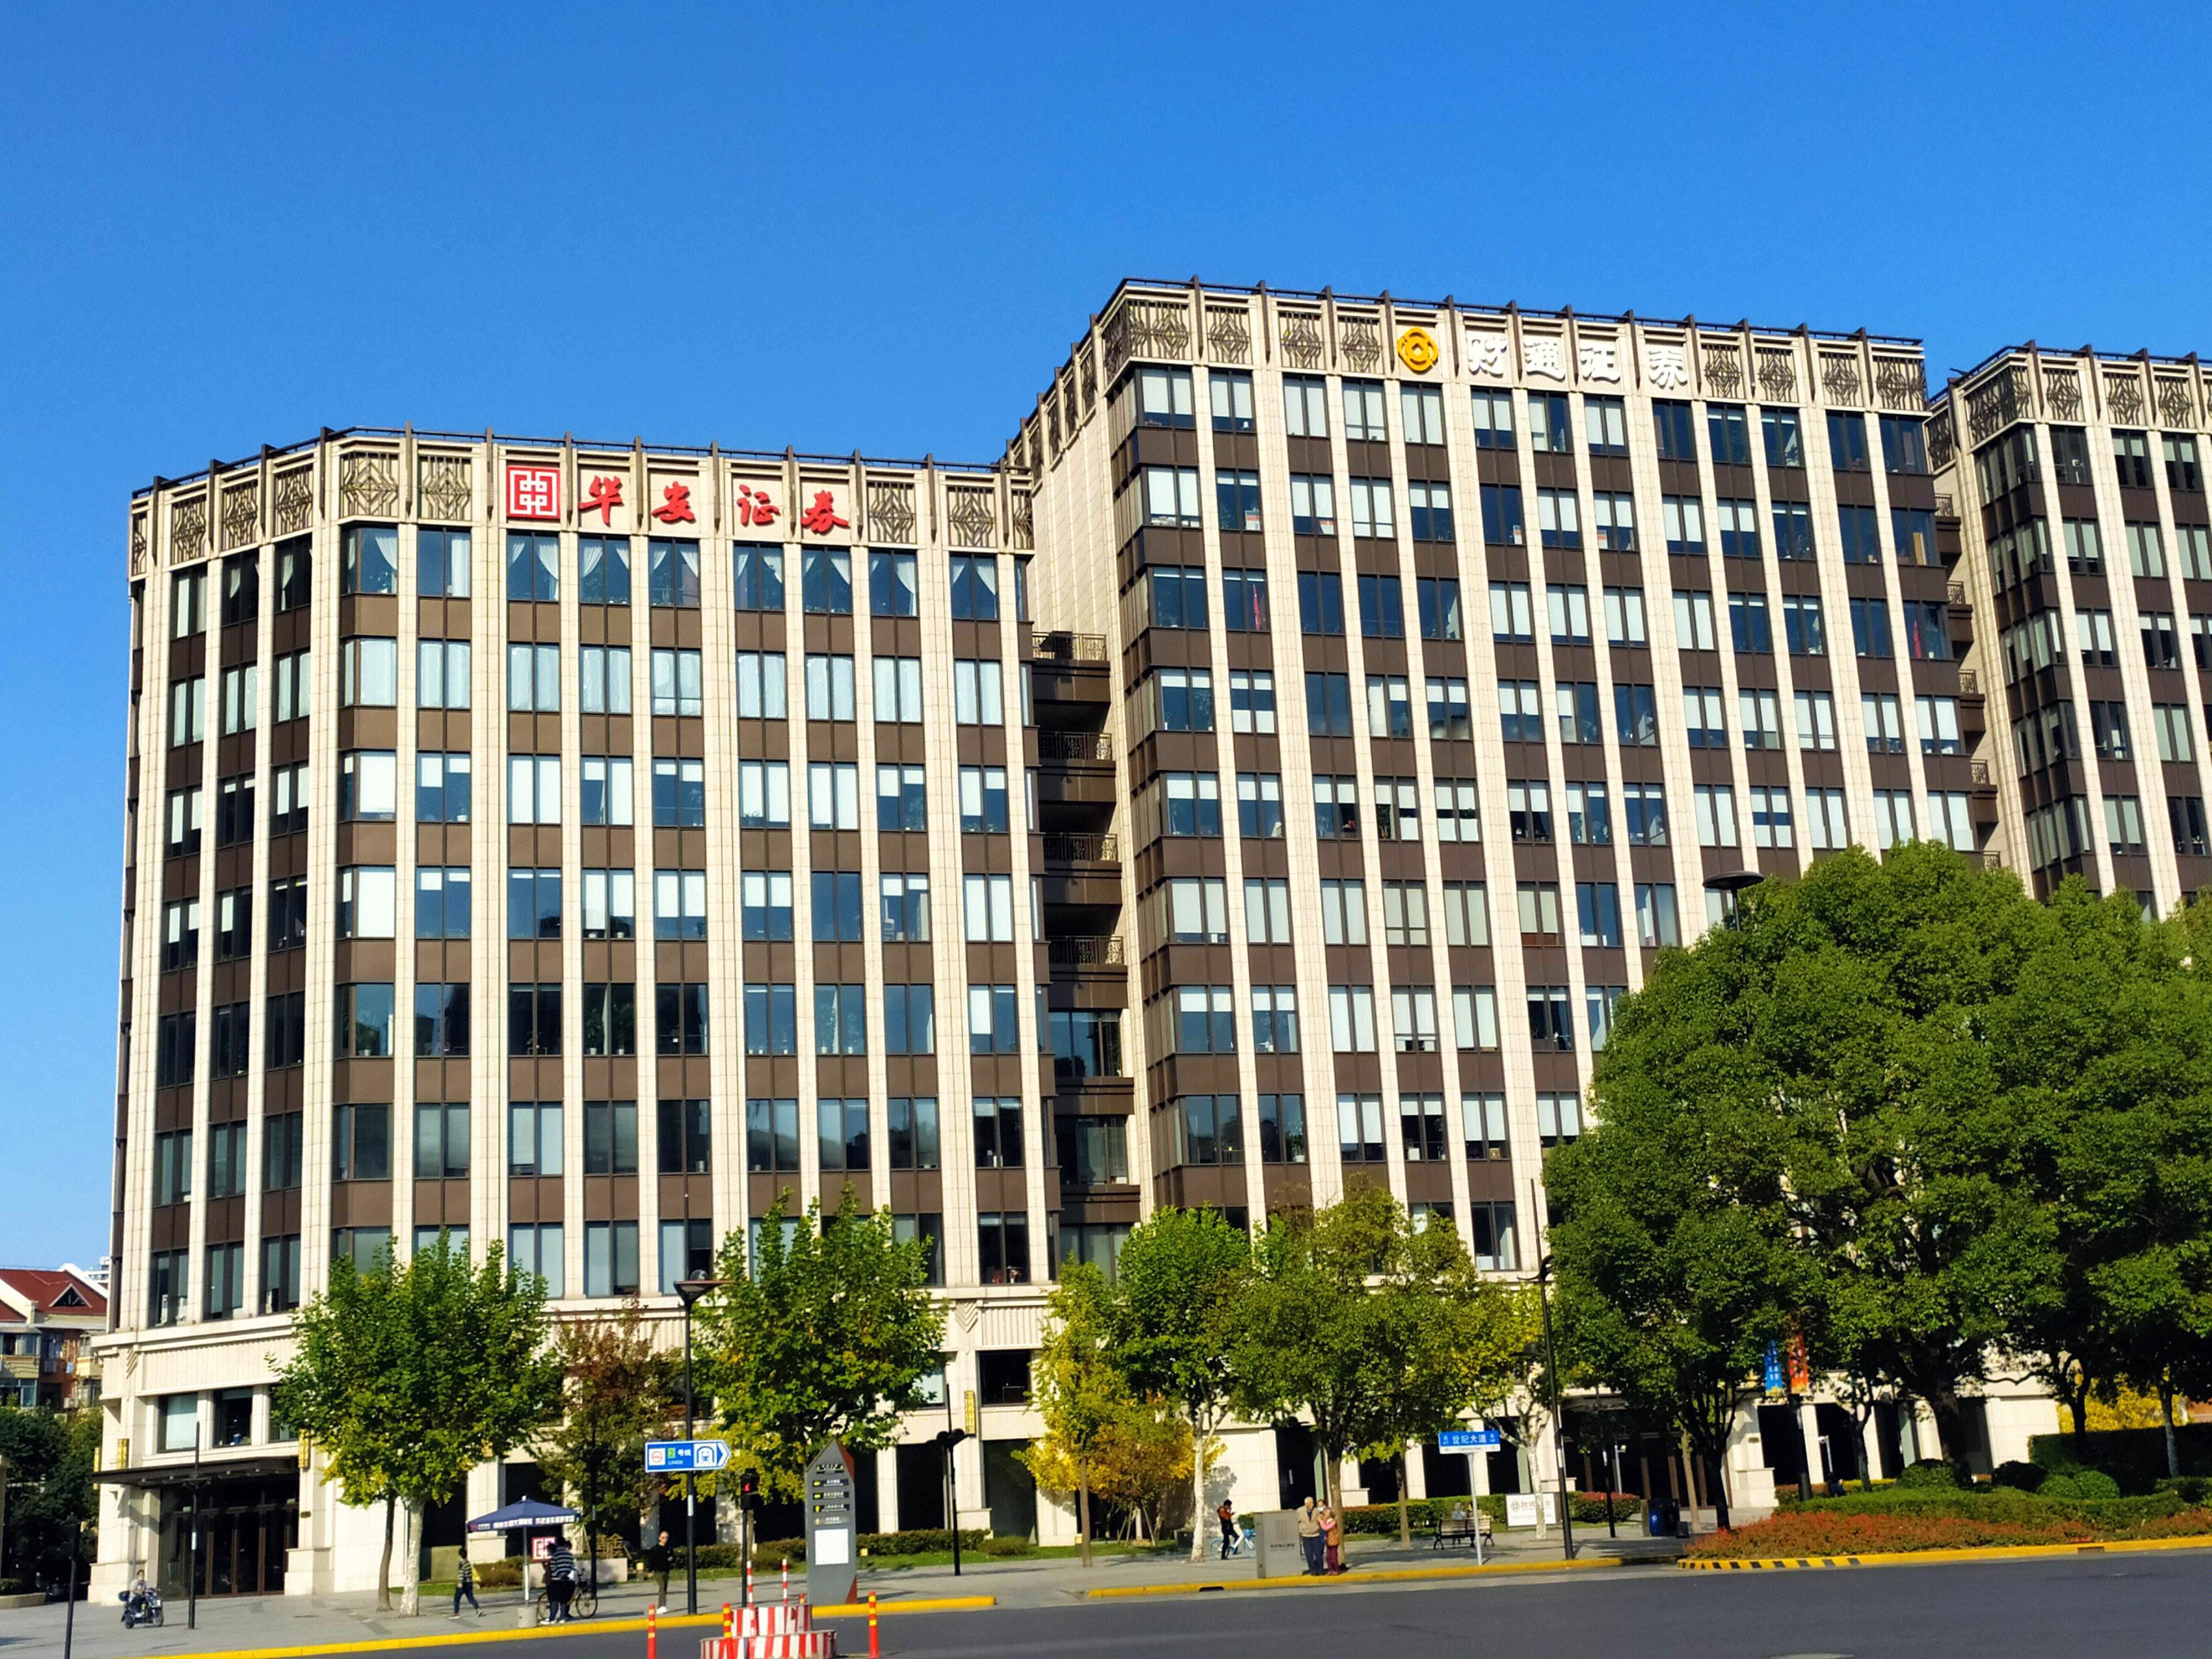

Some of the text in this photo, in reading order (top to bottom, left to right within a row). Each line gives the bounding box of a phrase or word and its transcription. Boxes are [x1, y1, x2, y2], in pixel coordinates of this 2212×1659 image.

[578, 474, 850, 533] 华安证券
[1452, 1434, 1486, 1444] 世纪大道
